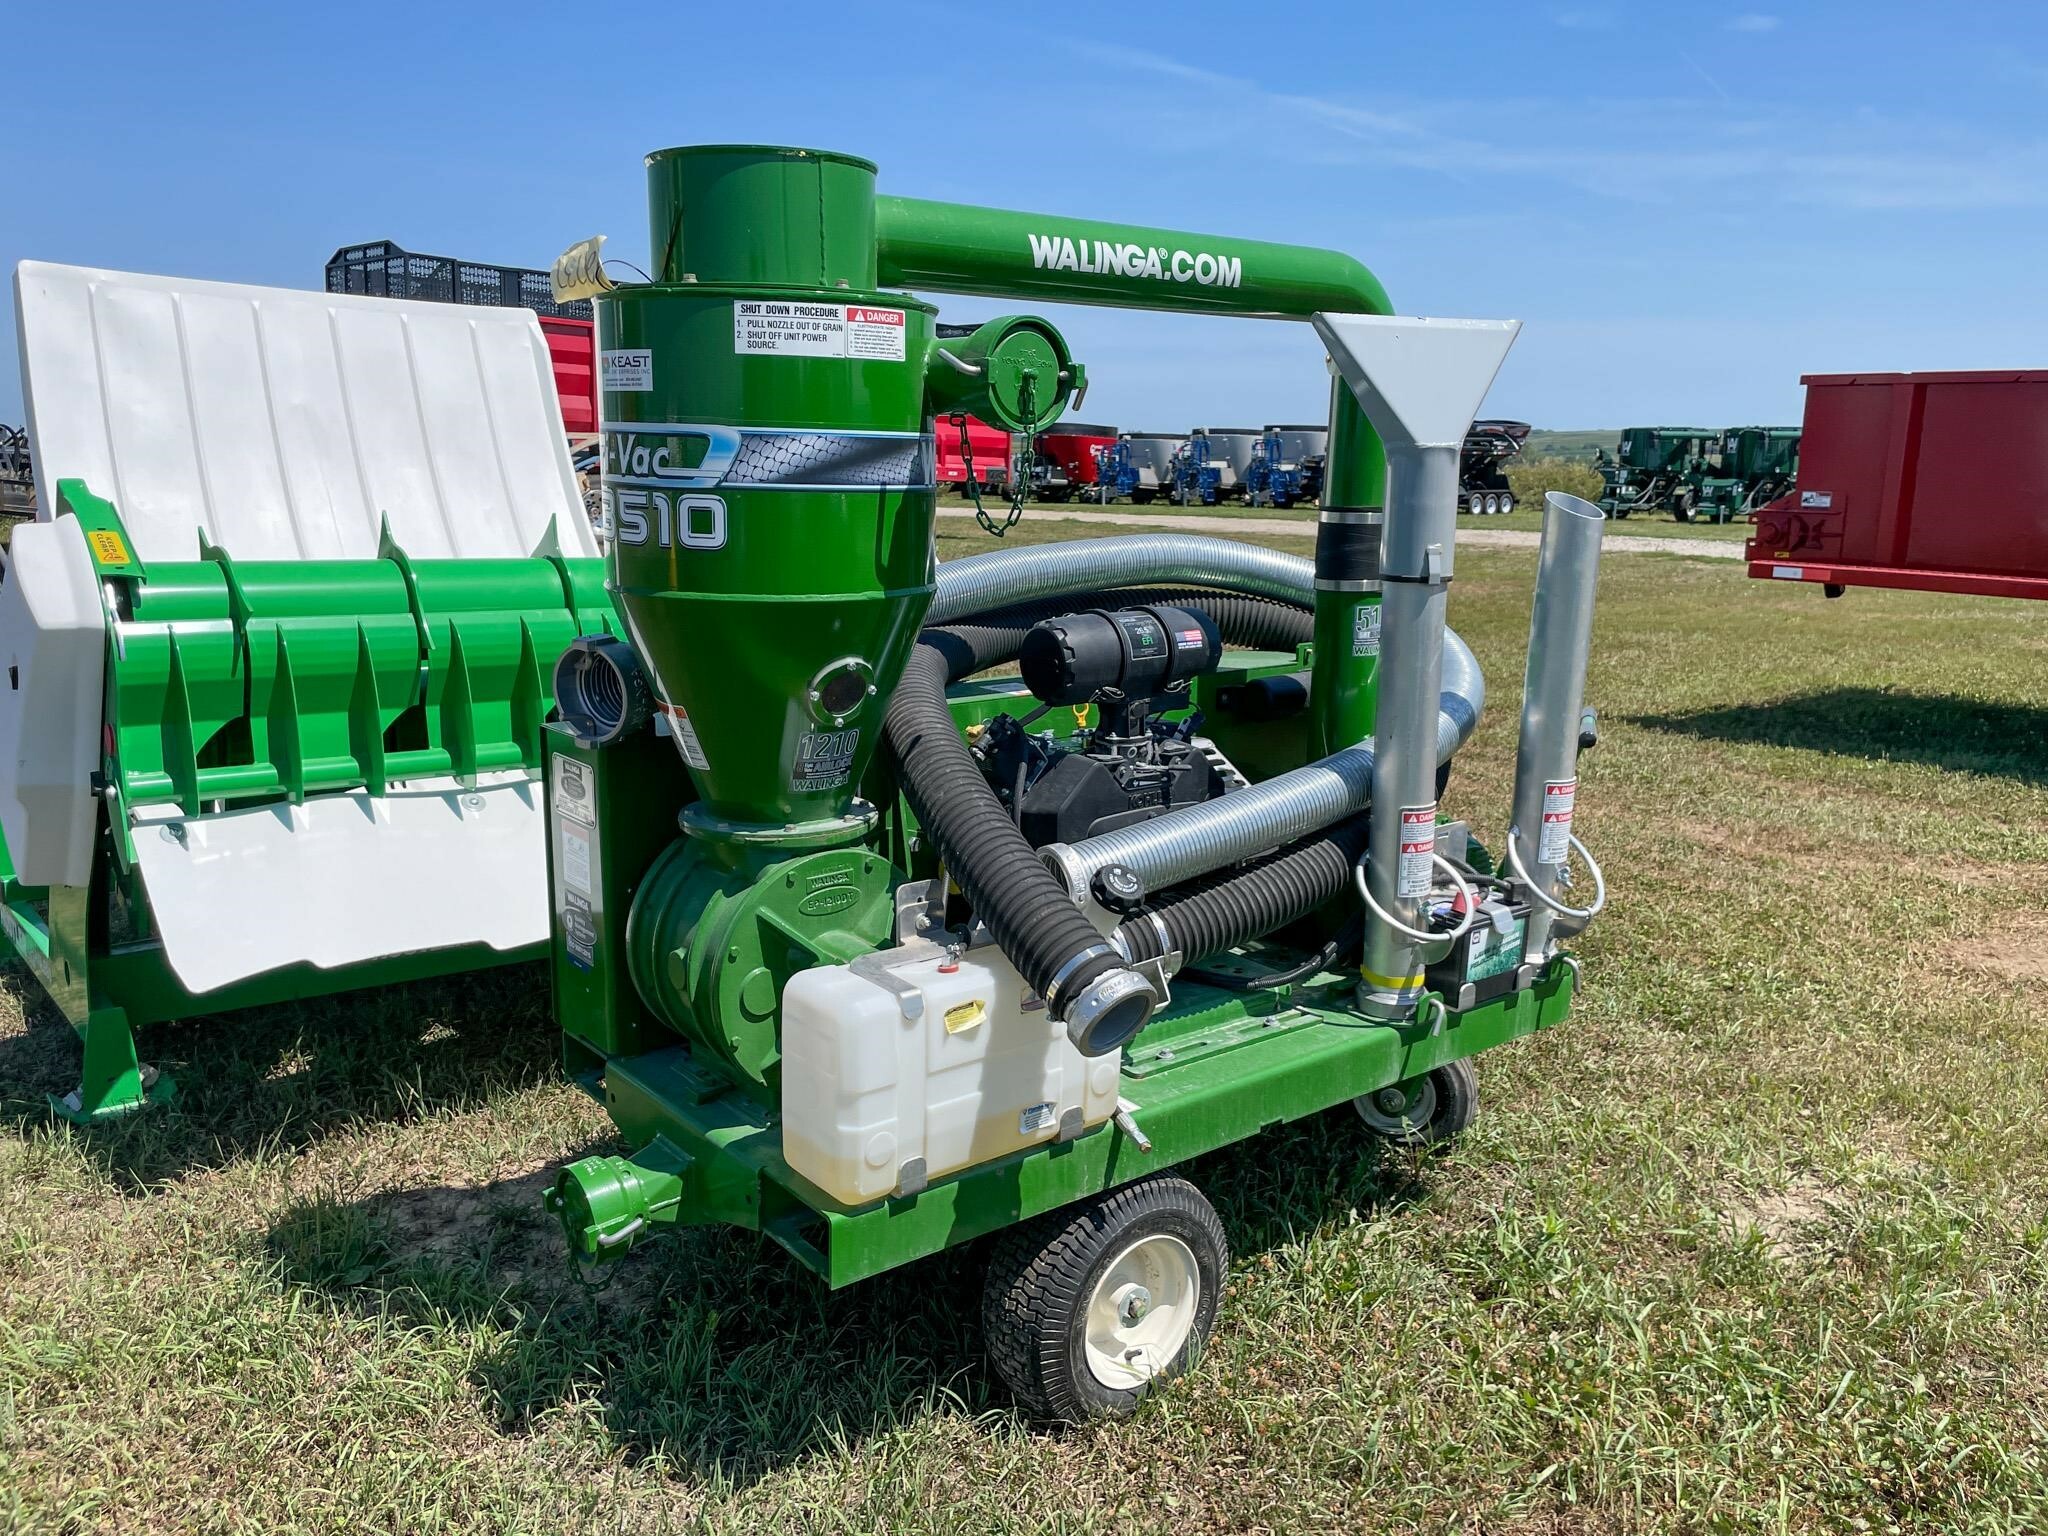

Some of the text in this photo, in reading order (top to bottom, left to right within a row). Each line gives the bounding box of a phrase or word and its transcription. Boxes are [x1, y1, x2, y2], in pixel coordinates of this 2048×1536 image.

[741, 304, 840, 318] SHUT DOWN PROCEDURE
[867, 311, 899, 323] DANGER
[736, 319, 744, 328] 1.
[747, 320, 766, 329] PULL
[767, 320, 795, 330] NOZZLE
[796, 321, 812, 331] OUT
[812, 322, 822, 331] OF
[822, 323, 843, 332] GRAIN
[736, 331, 828, 342] 2. SHUT OFF UNIT POWER
[611, 355, 650, 368] KEAST
[801, 728, 860, 760] 1210
[793, 774, 849, 792] WALINGA
